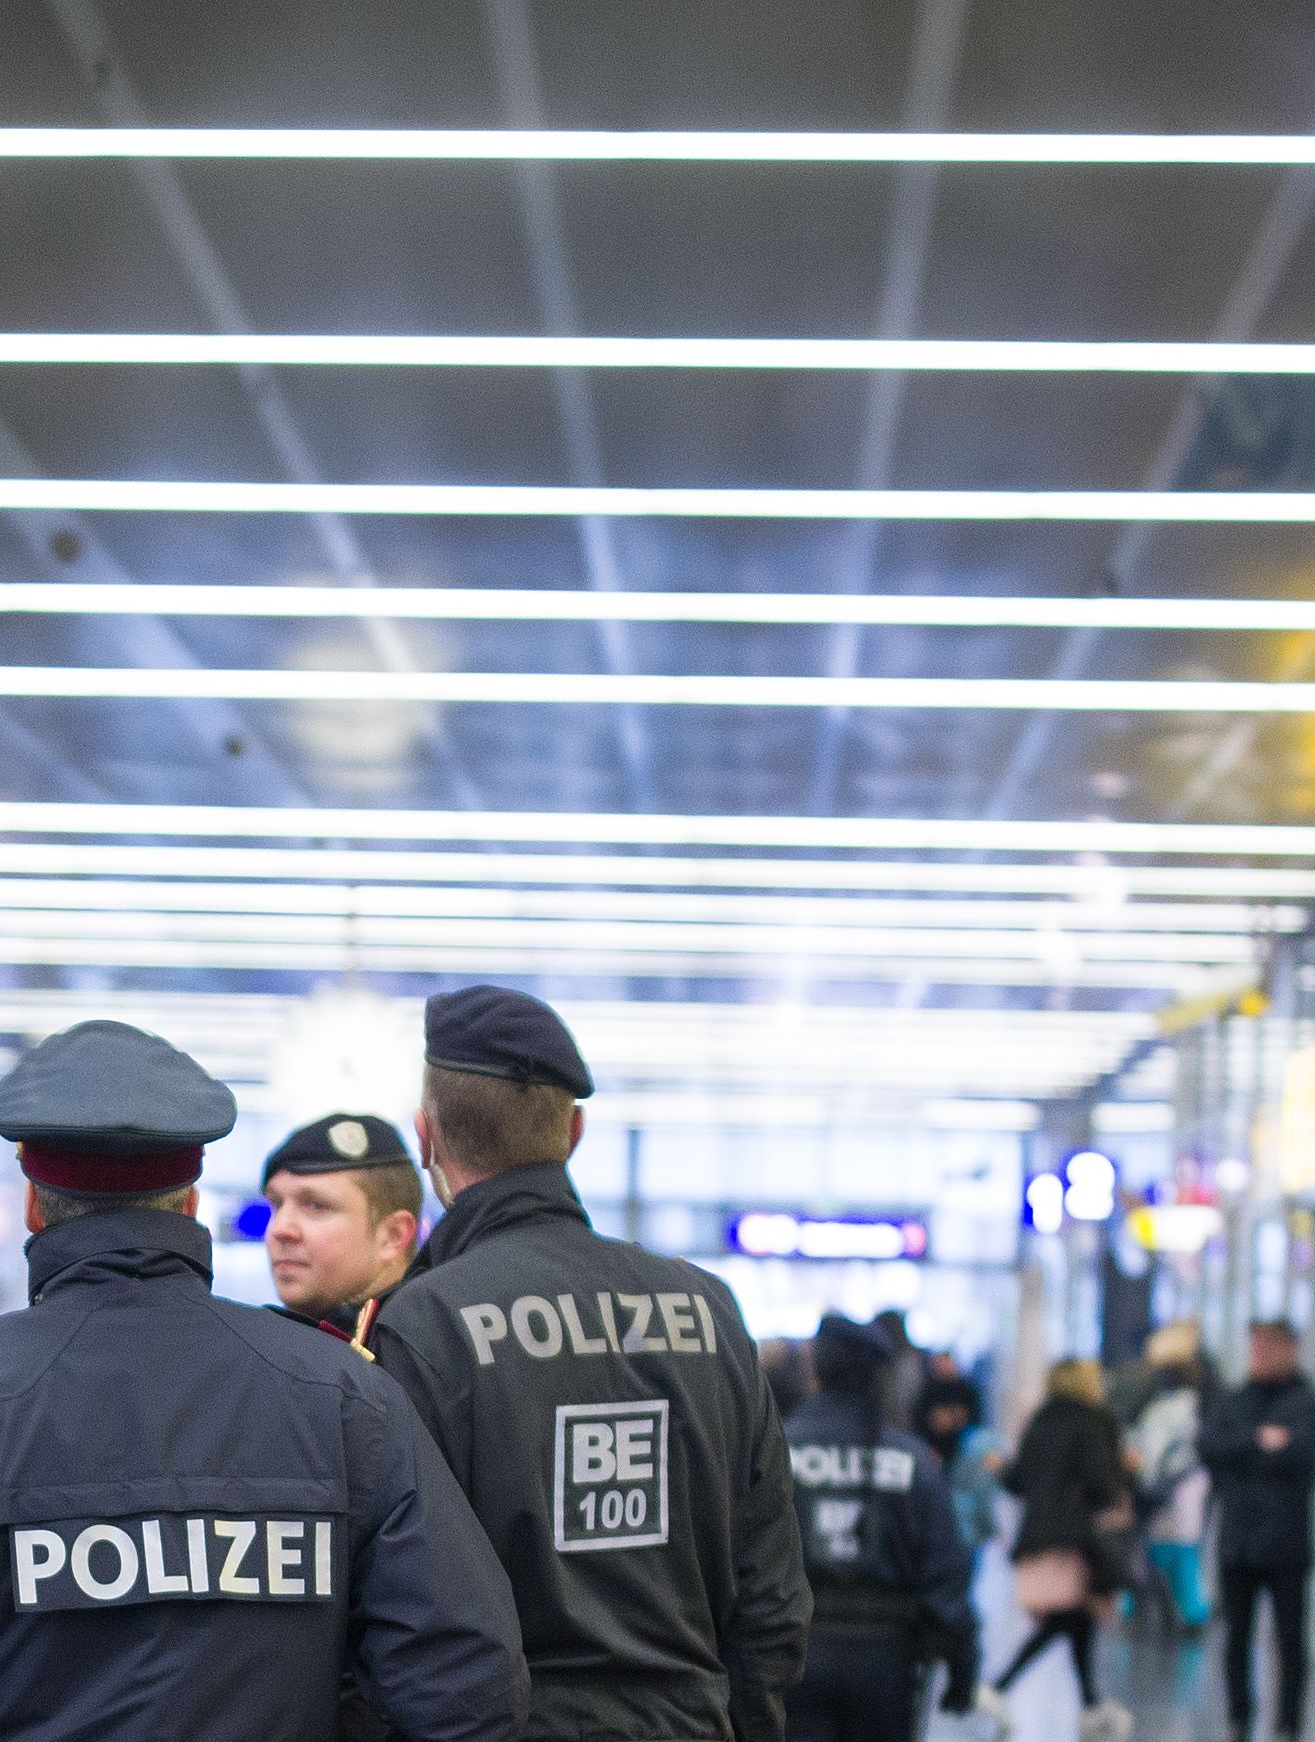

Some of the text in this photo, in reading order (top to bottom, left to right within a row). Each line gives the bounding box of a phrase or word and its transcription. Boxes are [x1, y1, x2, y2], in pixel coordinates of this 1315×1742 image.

[460, 1291, 717, 1366] POLIZEI
[573, 1419, 654, 1484] BE
[579, 1488, 647, 1530] 100
[14, 1518, 332, 1605] POLIZEI
